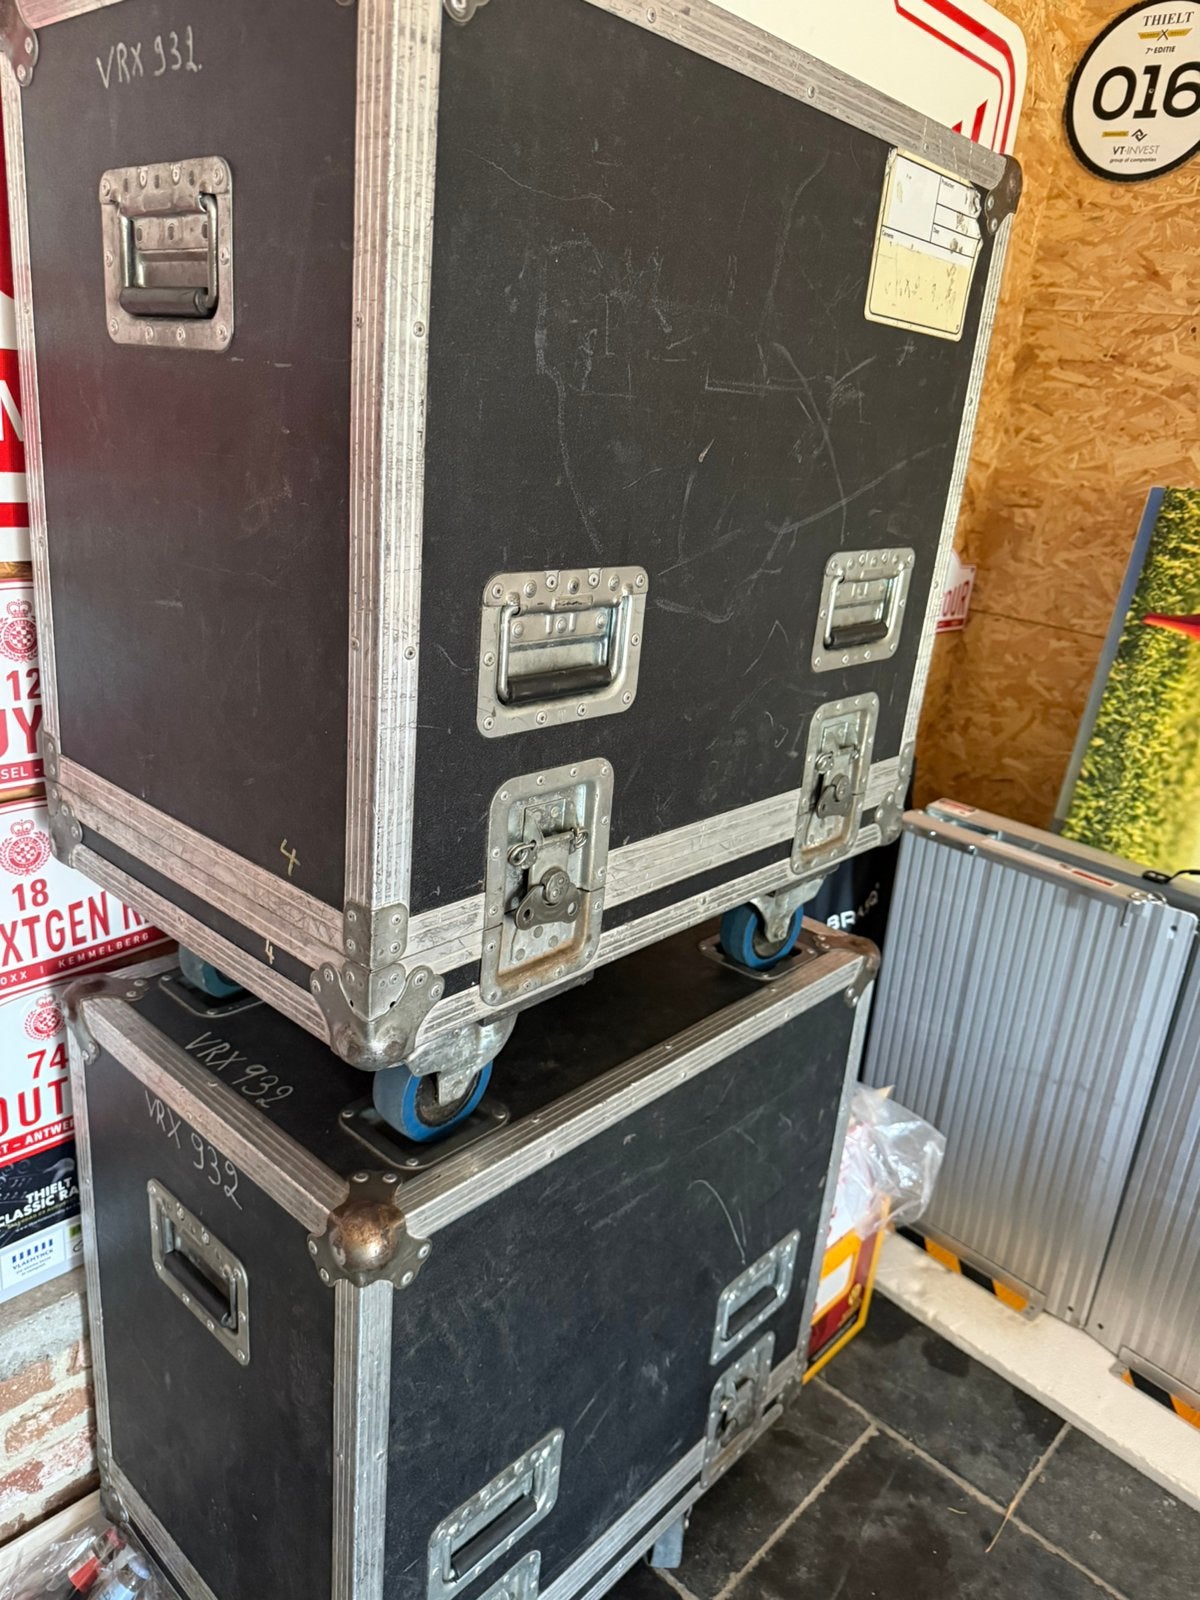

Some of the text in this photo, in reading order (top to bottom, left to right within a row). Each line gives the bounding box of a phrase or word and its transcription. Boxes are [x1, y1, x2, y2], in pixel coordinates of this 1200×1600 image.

[1143, 11, 1195, 27] THIELT
[95, 41, 144, 89] VRX
[1153, 45, 1176, 54] EDITIE
[1092, 61, 1200, 121] 016
[6, 667, 41, 702] 12
[280, 838, 301, 877] 4
[11, 878, 49, 911] 18
[58, 932, 149, 969] KEMMELBERG
[264, 939, 275, 965] 4
[27, 1042, 69, 1080] 74
[185, 1031, 294, 1109] VRX 932
[145, 1090, 243, 1211] VRX 932
[25, 1177, 73, 1204] THIELT
